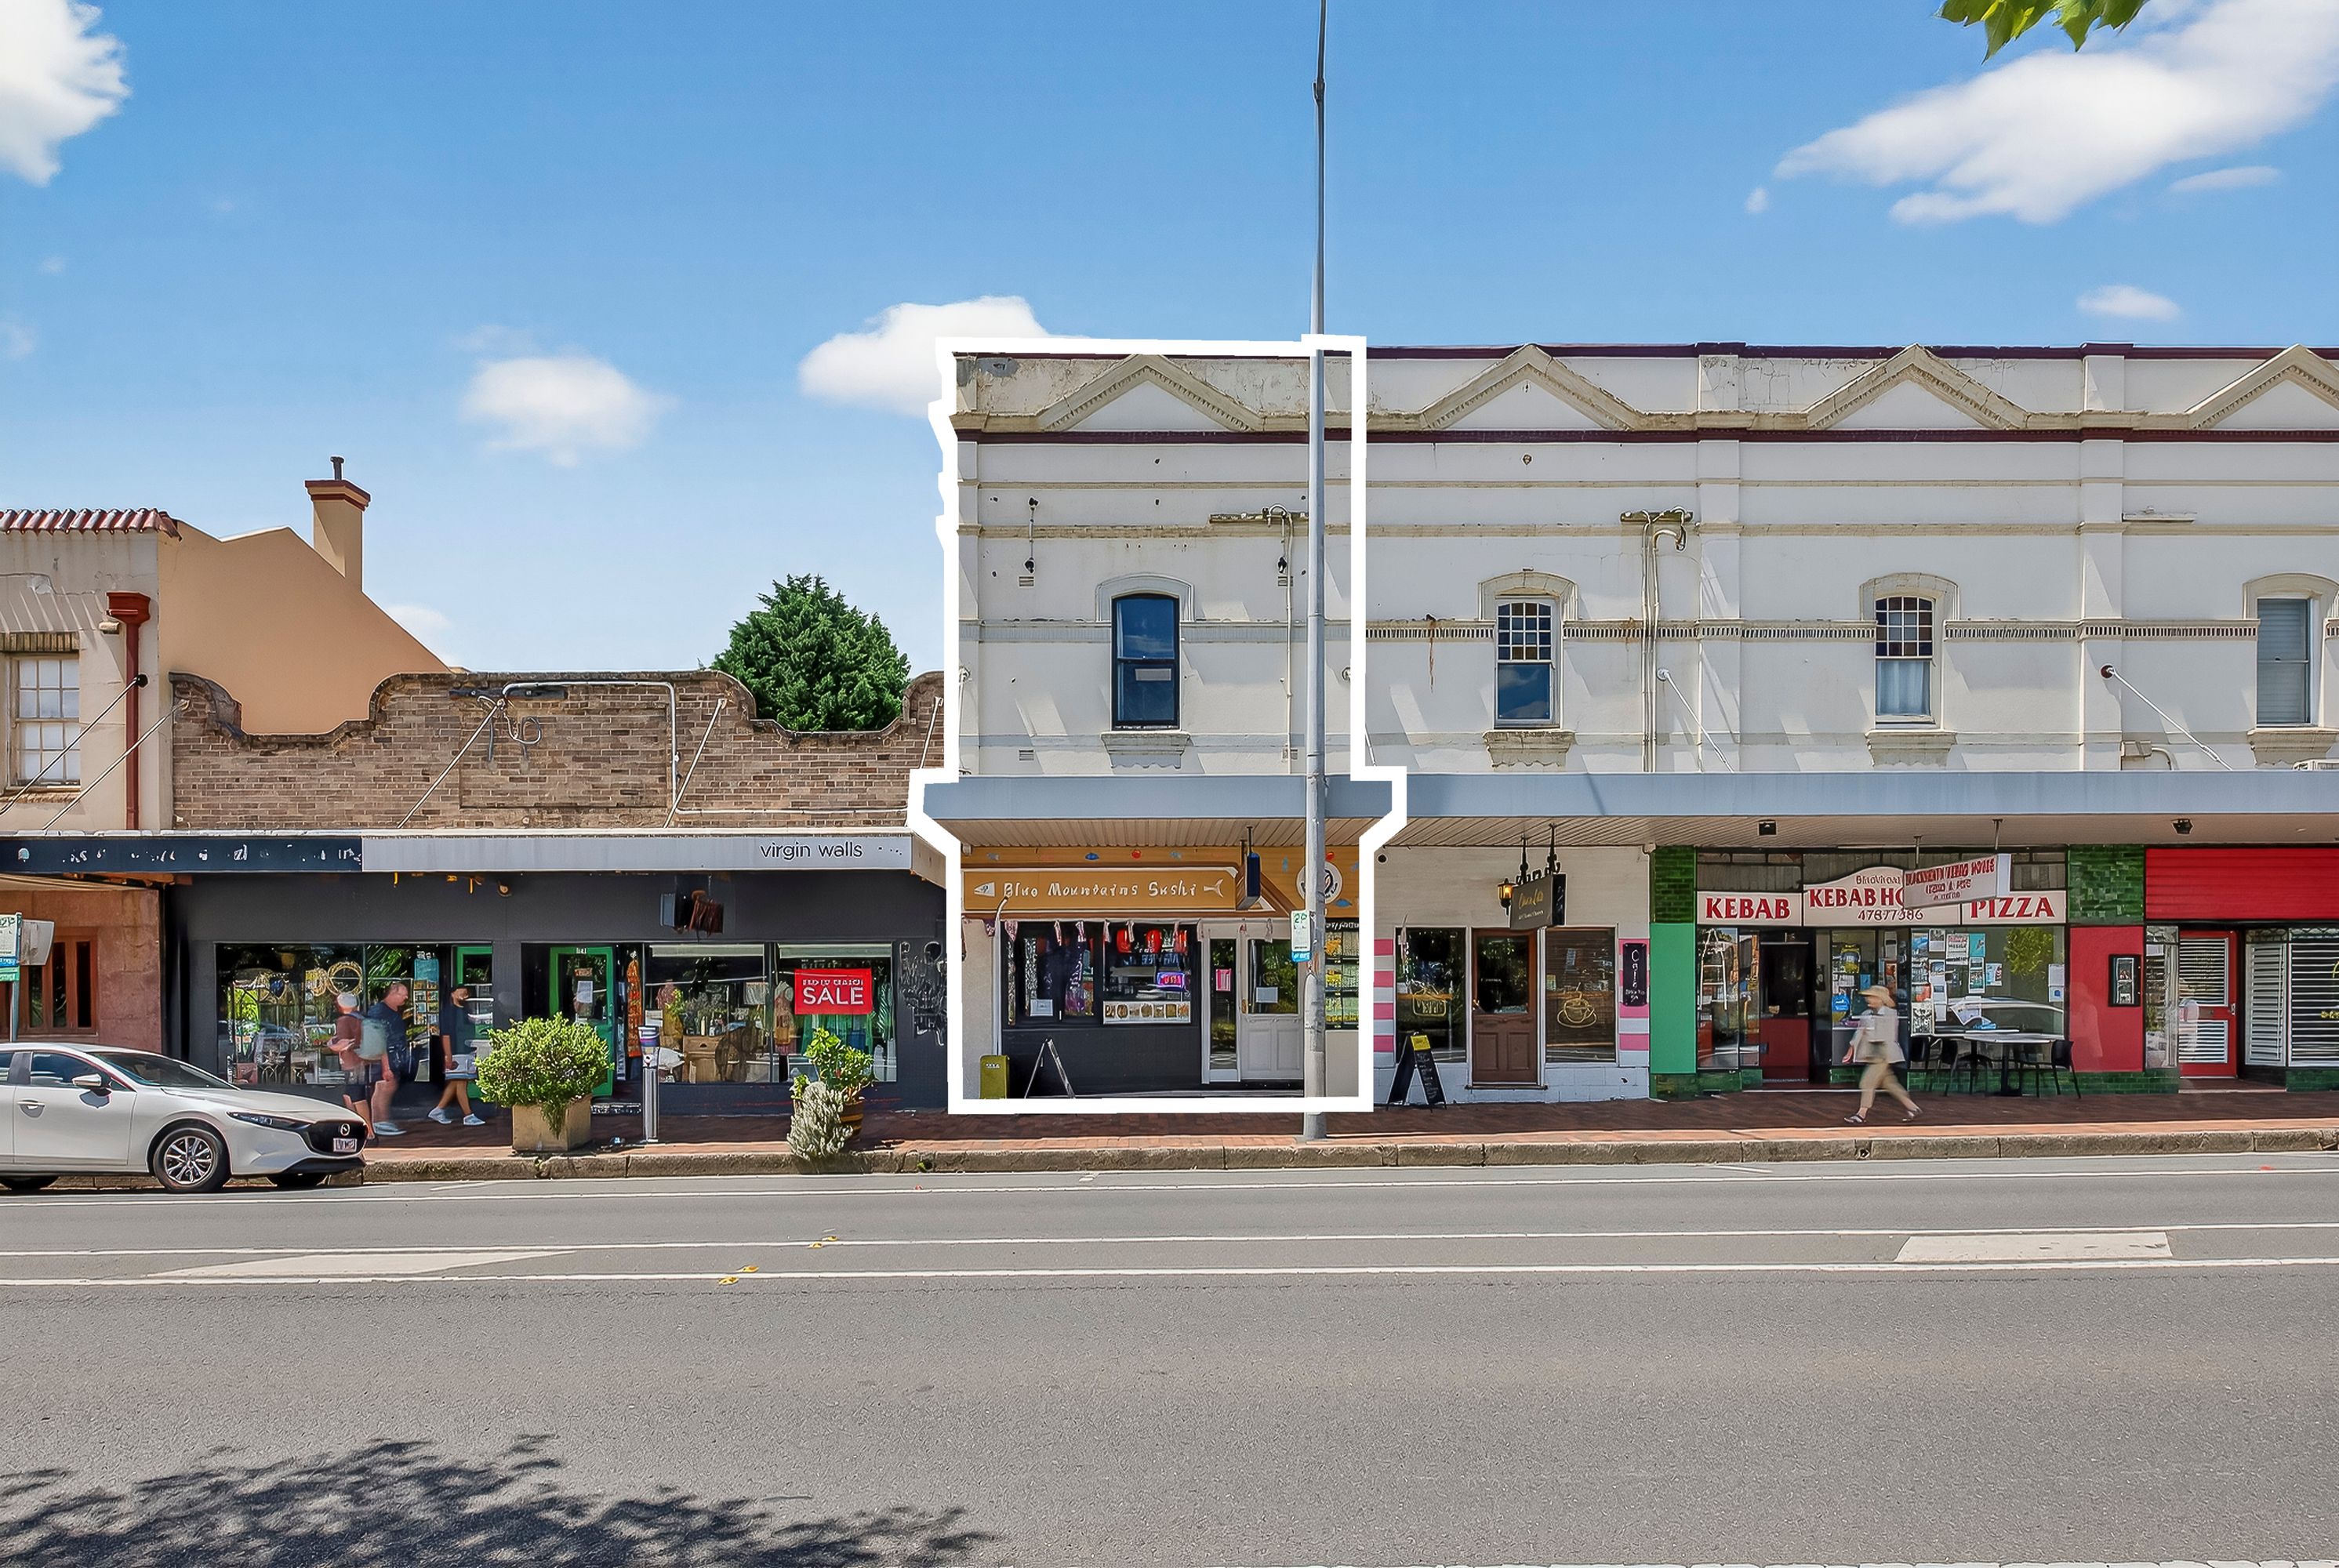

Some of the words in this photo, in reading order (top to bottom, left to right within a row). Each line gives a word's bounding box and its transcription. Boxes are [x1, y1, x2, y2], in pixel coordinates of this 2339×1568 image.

[760, 841, 811, 861] virgin
[818, 841, 863, 858] walls
[1809, 887, 1877, 907] KEBAB
[1705, 898, 1790, 919] KEBAB
[1970, 897, 2055, 918] PIZZA
[802, 986, 864, 1005] SALE
